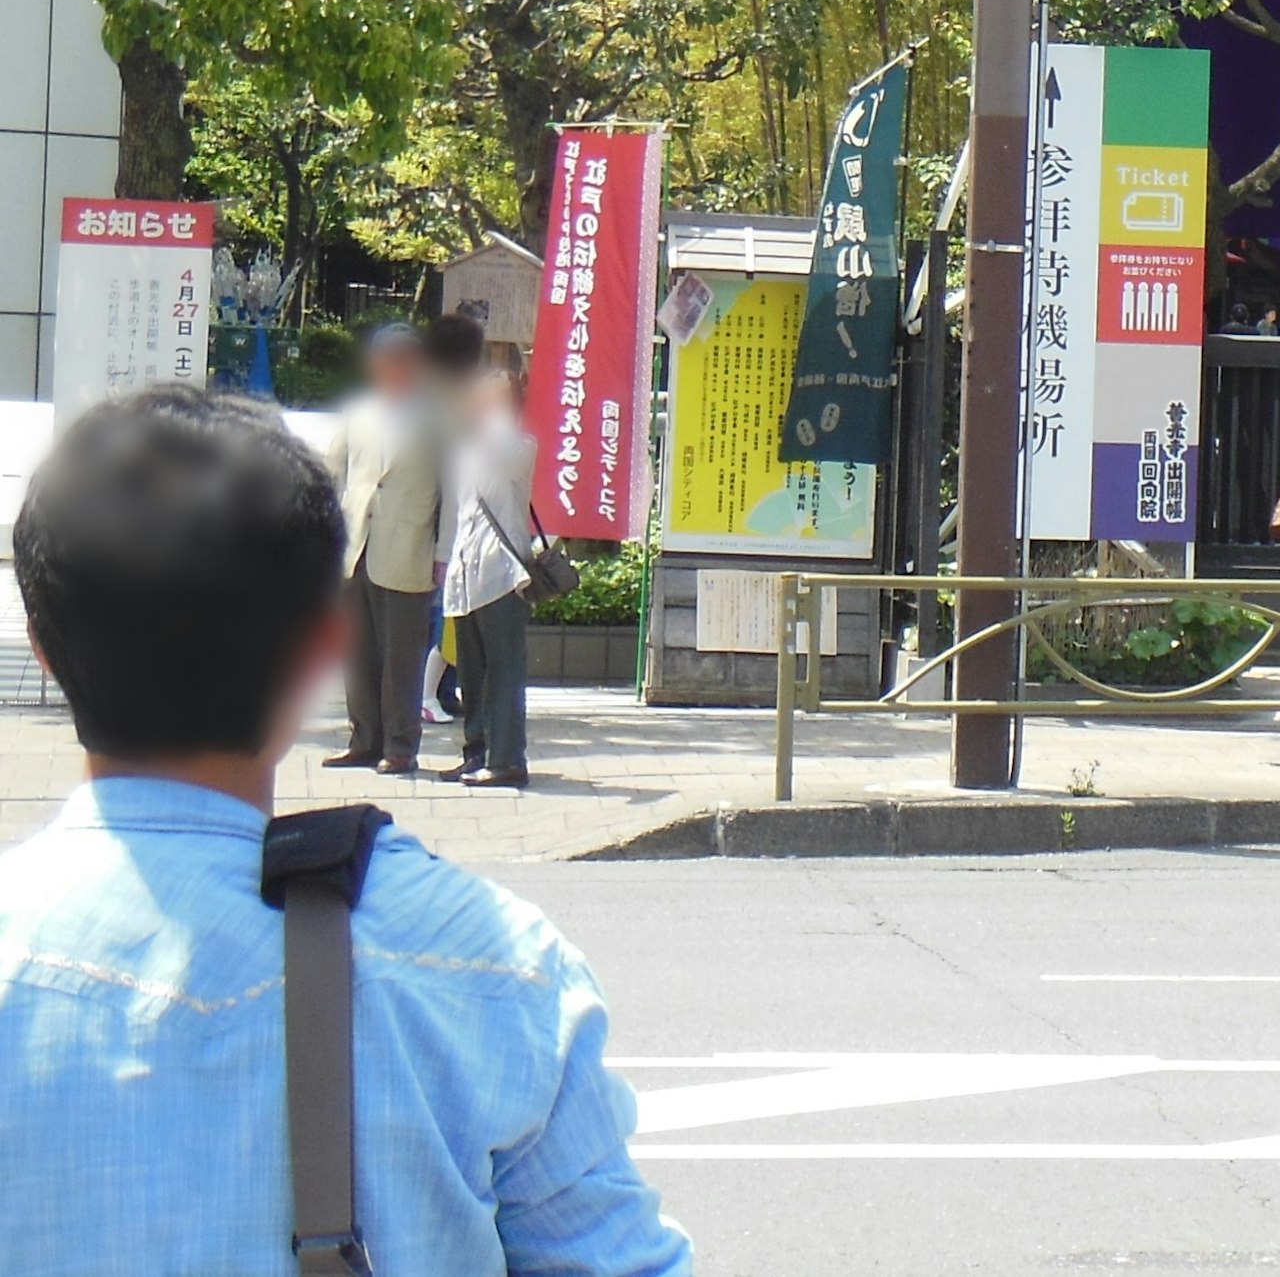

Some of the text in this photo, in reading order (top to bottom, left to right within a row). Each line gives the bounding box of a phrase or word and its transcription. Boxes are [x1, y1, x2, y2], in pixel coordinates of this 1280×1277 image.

[1117, 166, 1190, 187] Ticket
[78, 209, 197, 239] お知らせ
